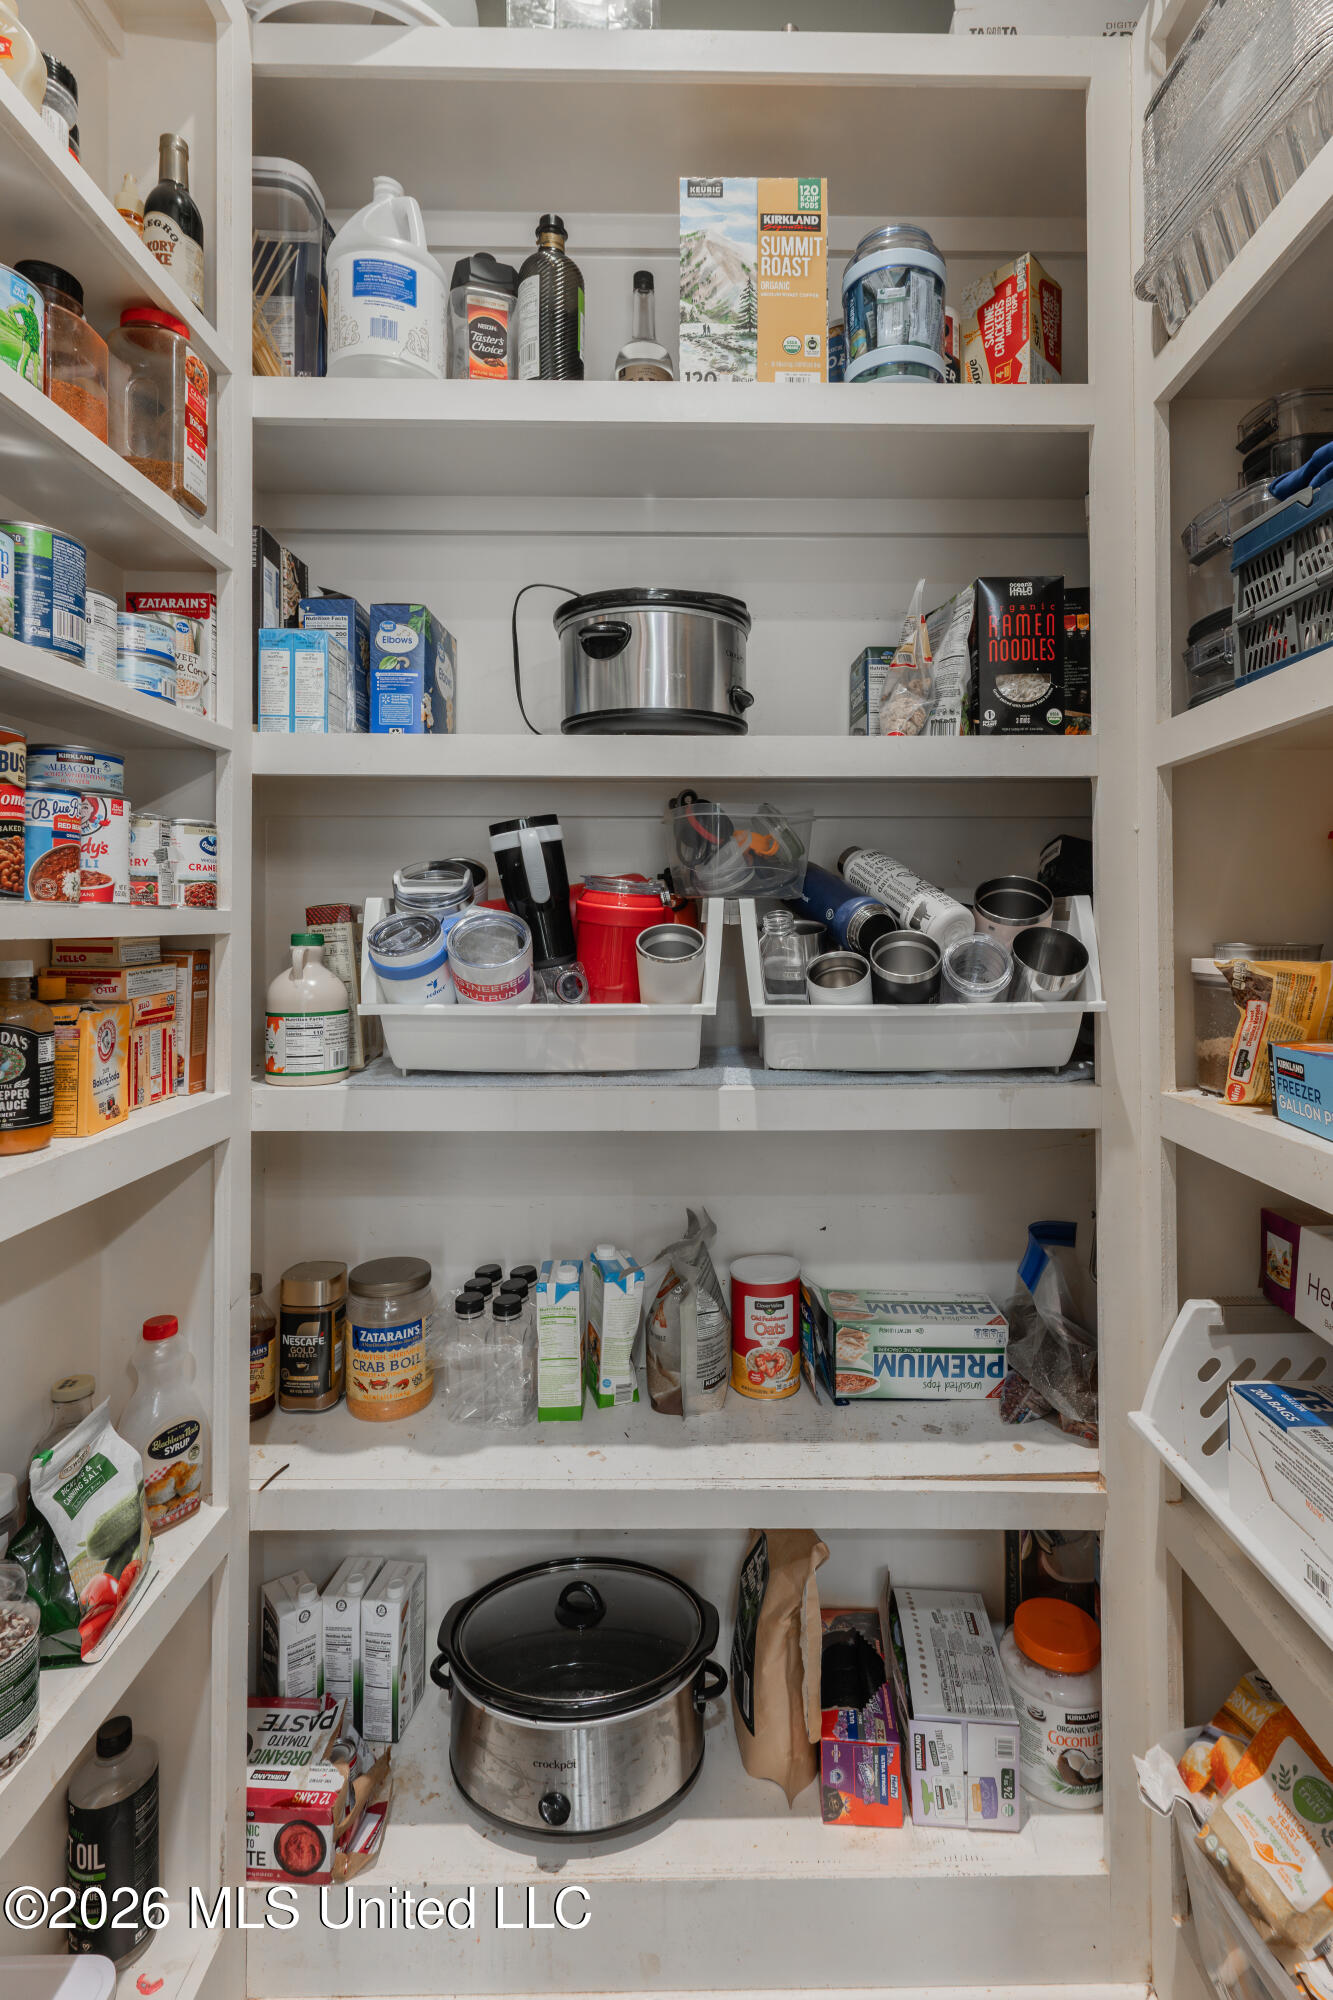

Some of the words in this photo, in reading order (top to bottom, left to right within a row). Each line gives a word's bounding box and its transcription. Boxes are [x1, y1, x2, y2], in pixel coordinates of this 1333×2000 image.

[800, 185, 819, 196] 120
[763, 214, 819, 225] KIRKLAND
[144, 219, 179, 242] EGRO
[760, 236, 823, 257] SUMMIT
[760, 256, 811, 278] ROAST
[760, 280, 790, 291] ORGANIC
[984, 303, 995, 349] SALTINE
[994, 299, 1005, 357] CRACKERS
[470, 330, 505, 346] Taster's
[472, 341, 504, 355] Choice
[139, 598, 208, 609] ZATARAIN'S
[988, 613, 1055, 638] RAMEN
[382, 635, 413, 645] Elbows
[988, 638, 1056, 663] NOODLES
[58, 752, 94, 761] KIRKLAND
[48, 763, 102, 775] ALBACORE
[461, 988, 518, 1002] OUTRUN
[1276, 1057, 1304, 1073] KIRKLAND
[92, 1076, 109, 1089] Baking
[109, 1071, 120, 1083] Soda
[1231, 1083, 1242, 1103] Mini
[1277, 1077, 1321, 1105] FREEZER
[1278, 1094, 1322, 1123] GALLON
[866, 1303, 997, 1315] PREMIUM
[360, 1324, 420, 1343] ZATARAIN'S
[754, 1322, 786, 1336] Oats
[282, 1331, 325, 1346] NESCAFÉ
[290, 1346, 315, 1354] GOLD
[352, 1358, 385, 1373] CRAB
[390, 1353, 421, 1371] BOIL
[873, 1353, 1005, 1379] PREMIUM
[944, 1380, 982, 1392] unsalted
[1250, 1388, 1273, 1400] 200
[1266, 1401, 1300, 1422] BAGS
[164, 1437, 190, 1456] SYRUP
[82, 1464, 103, 1484] SALT
[256, 1706, 339, 1732] PASTE
[1066, 1714, 1099, 1722] KIRKLAND
[1056, 1724, 1085, 1734] ORGANIC
[266, 1735, 312, 1748] TOMATO
[1048, 1731, 1100, 1748] Coconut
[249, 1749, 313, 1767] ORGANIC
[915, 1734, 923, 1769] KIRKLAND
[533, 1758, 577, 1771] crockpot
[252, 1773, 288, 1781] KIRKLAND
[292, 1791, 319, 1804] CANS
[319, 1792, 332, 1804] 12
[1272, 1792, 1321, 1857] NUTRITIONAL
[1277, 1811, 1301, 1841] YEAST
[76, 1843, 106, 1871] OIL
